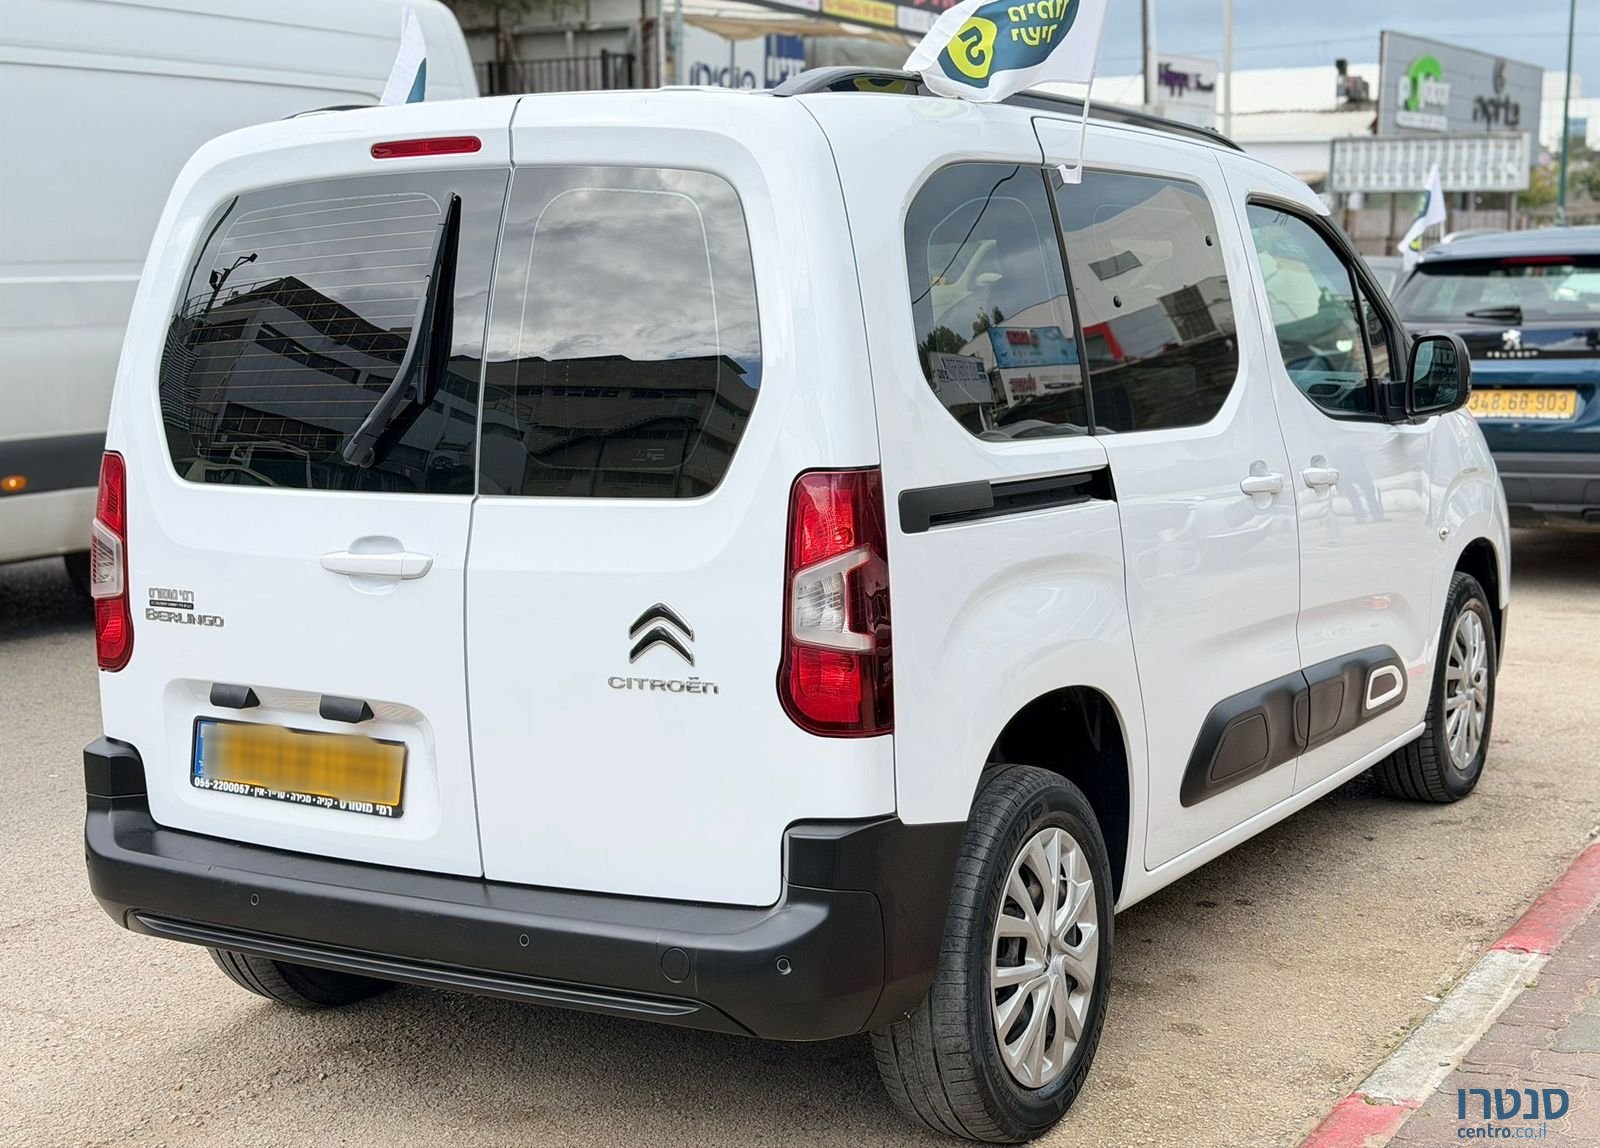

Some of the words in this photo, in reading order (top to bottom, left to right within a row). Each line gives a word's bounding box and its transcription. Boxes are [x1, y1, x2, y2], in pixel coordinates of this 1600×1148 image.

[145, 608, 225, 627] BERLINGO
[194, 776, 250, 795] 055-2200057
[290, 792, 312, 804] מכירה
[316, 796, 334, 808] קניה
[375, 804, 393, 816] רמי
